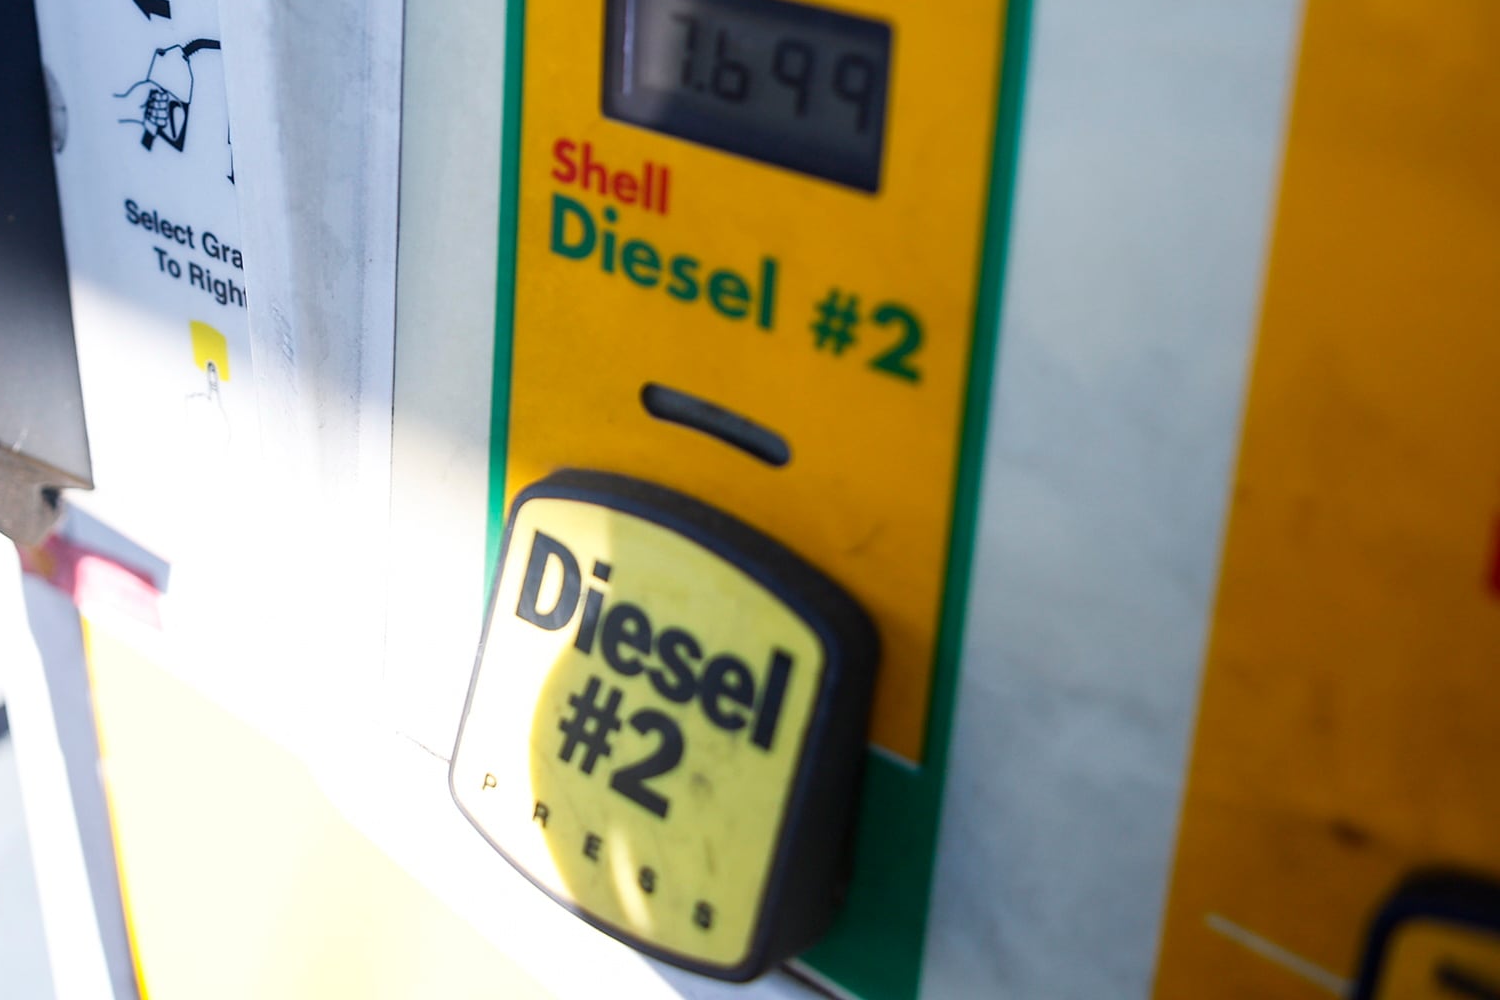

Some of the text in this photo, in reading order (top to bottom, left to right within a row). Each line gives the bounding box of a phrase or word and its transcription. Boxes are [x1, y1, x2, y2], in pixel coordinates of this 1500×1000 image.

[124, 198, 195, 251] Select
[551, 139, 671, 217] Shell
[154, 246, 182, 279] To
[550, 192, 925, 385] Diesel #2
[515, 530, 795, 753] Diesel
[557, 676, 685, 820] #2
